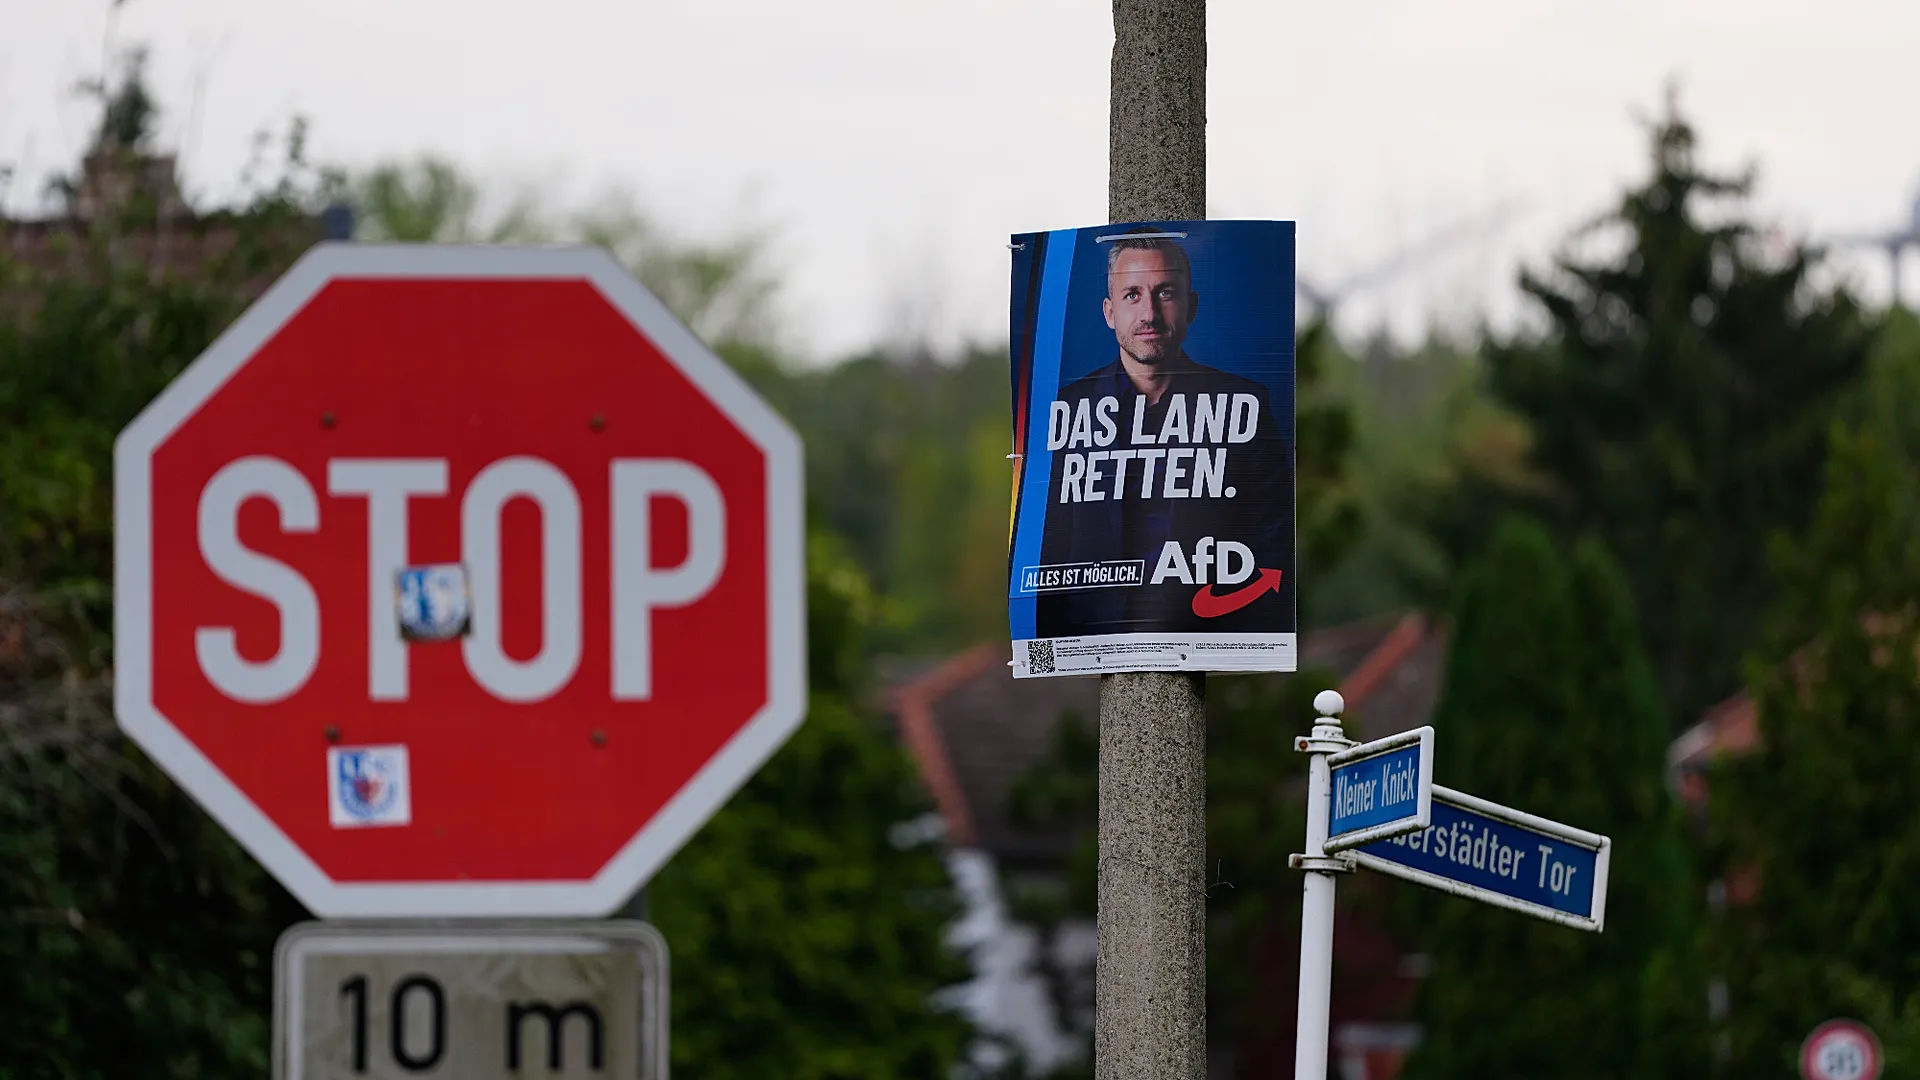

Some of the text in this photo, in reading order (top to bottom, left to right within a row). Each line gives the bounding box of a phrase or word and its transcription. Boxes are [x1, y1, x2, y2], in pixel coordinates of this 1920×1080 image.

[1047, 393, 1260, 451] DAS LAND
[1059, 448, 1237, 504] RETTEN.
[195, 455, 728, 703] STOP
[1025, 563, 1140, 588] ALLES IST MÖGLICH.
[1149, 536, 1256, 586] AfD
[1335, 757, 1416, 820] Kleiner Knick
[1385, 820, 1577, 896] erstädter Tor
[340, 974, 606, 1074] 10 m
